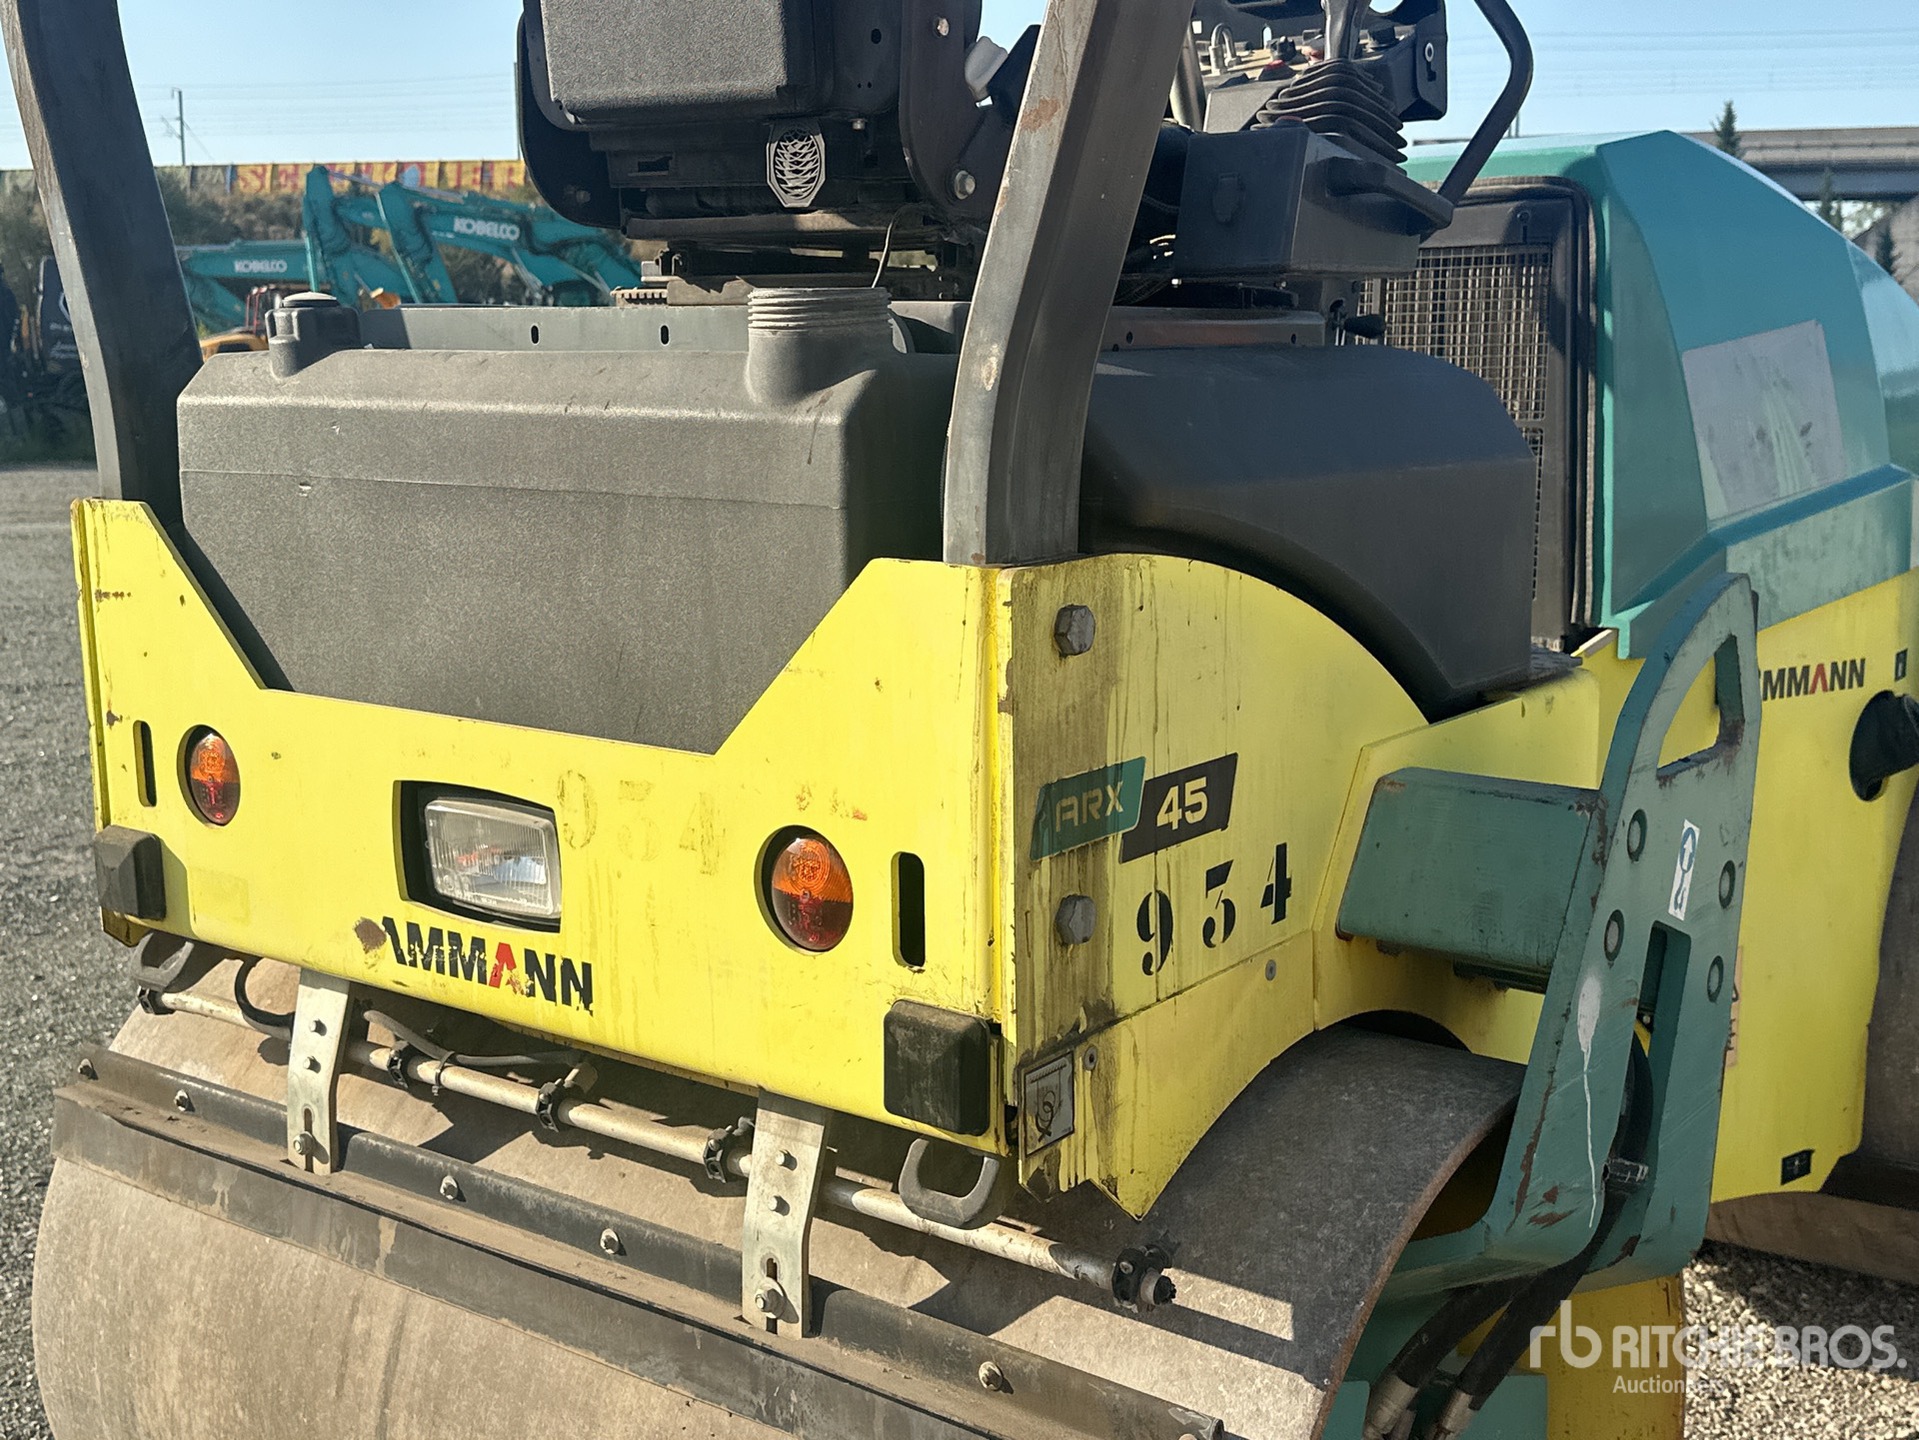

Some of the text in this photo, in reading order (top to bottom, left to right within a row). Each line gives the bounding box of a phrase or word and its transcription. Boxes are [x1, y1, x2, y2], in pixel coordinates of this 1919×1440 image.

[454, 216, 520, 240] KOBELCO
[234, 259, 288, 273] KOBELCO
[1758, 658, 1866, 701] MMANN
[1055, 776, 1208, 832] ARX 45
[1136, 842, 1292, 976] 934
